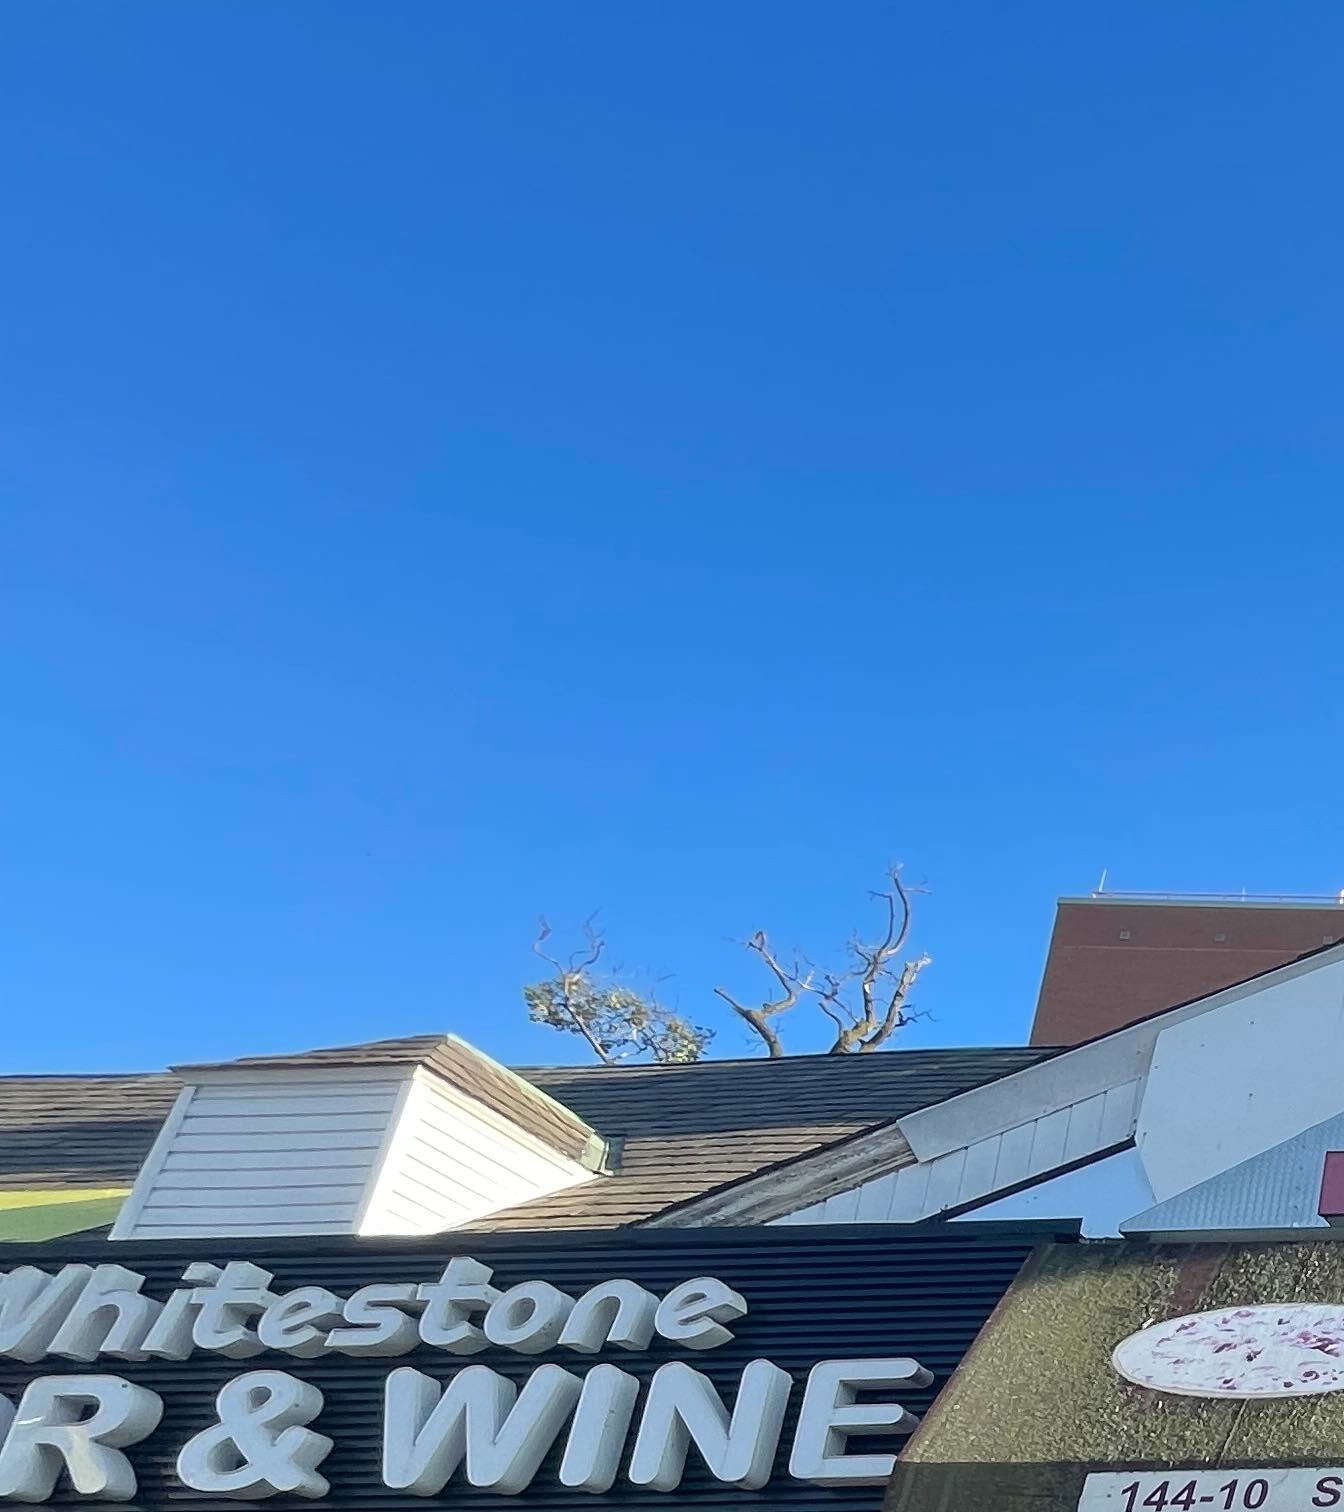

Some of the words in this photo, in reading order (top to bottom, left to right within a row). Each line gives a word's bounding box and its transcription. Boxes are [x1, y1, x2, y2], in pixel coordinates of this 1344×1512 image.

[0, 1374, 163, 1502] R
[176, 1369, 333, 1499] &
[382, 1357, 933, 1495] WINE
[1120, 1478, 1270, 1512] 144-10
